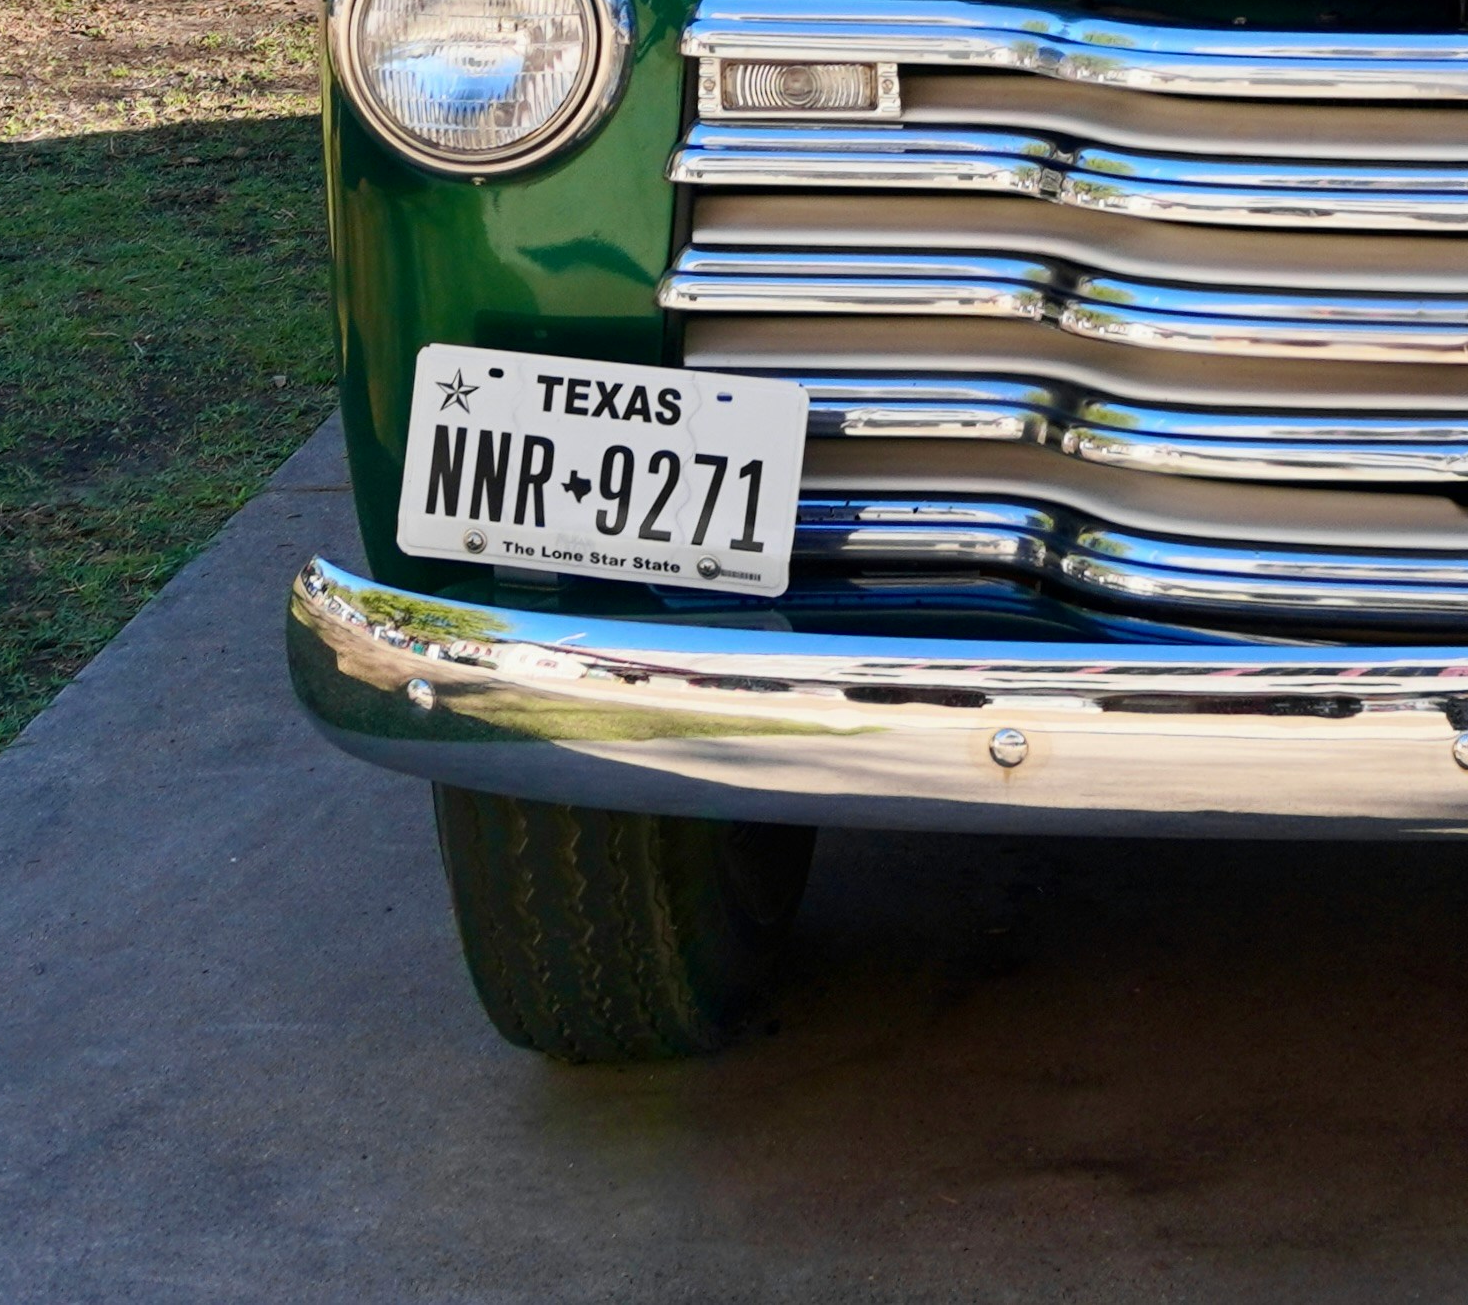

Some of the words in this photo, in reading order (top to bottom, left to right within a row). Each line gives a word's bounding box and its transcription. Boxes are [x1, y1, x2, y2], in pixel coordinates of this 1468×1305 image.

[537, 375, 682, 426] TEXAS
[503, 541, 535, 557] The
[542, 546, 583, 562] Lone
[590, 552, 626, 568] Star
[633, 557, 681, 573] State
